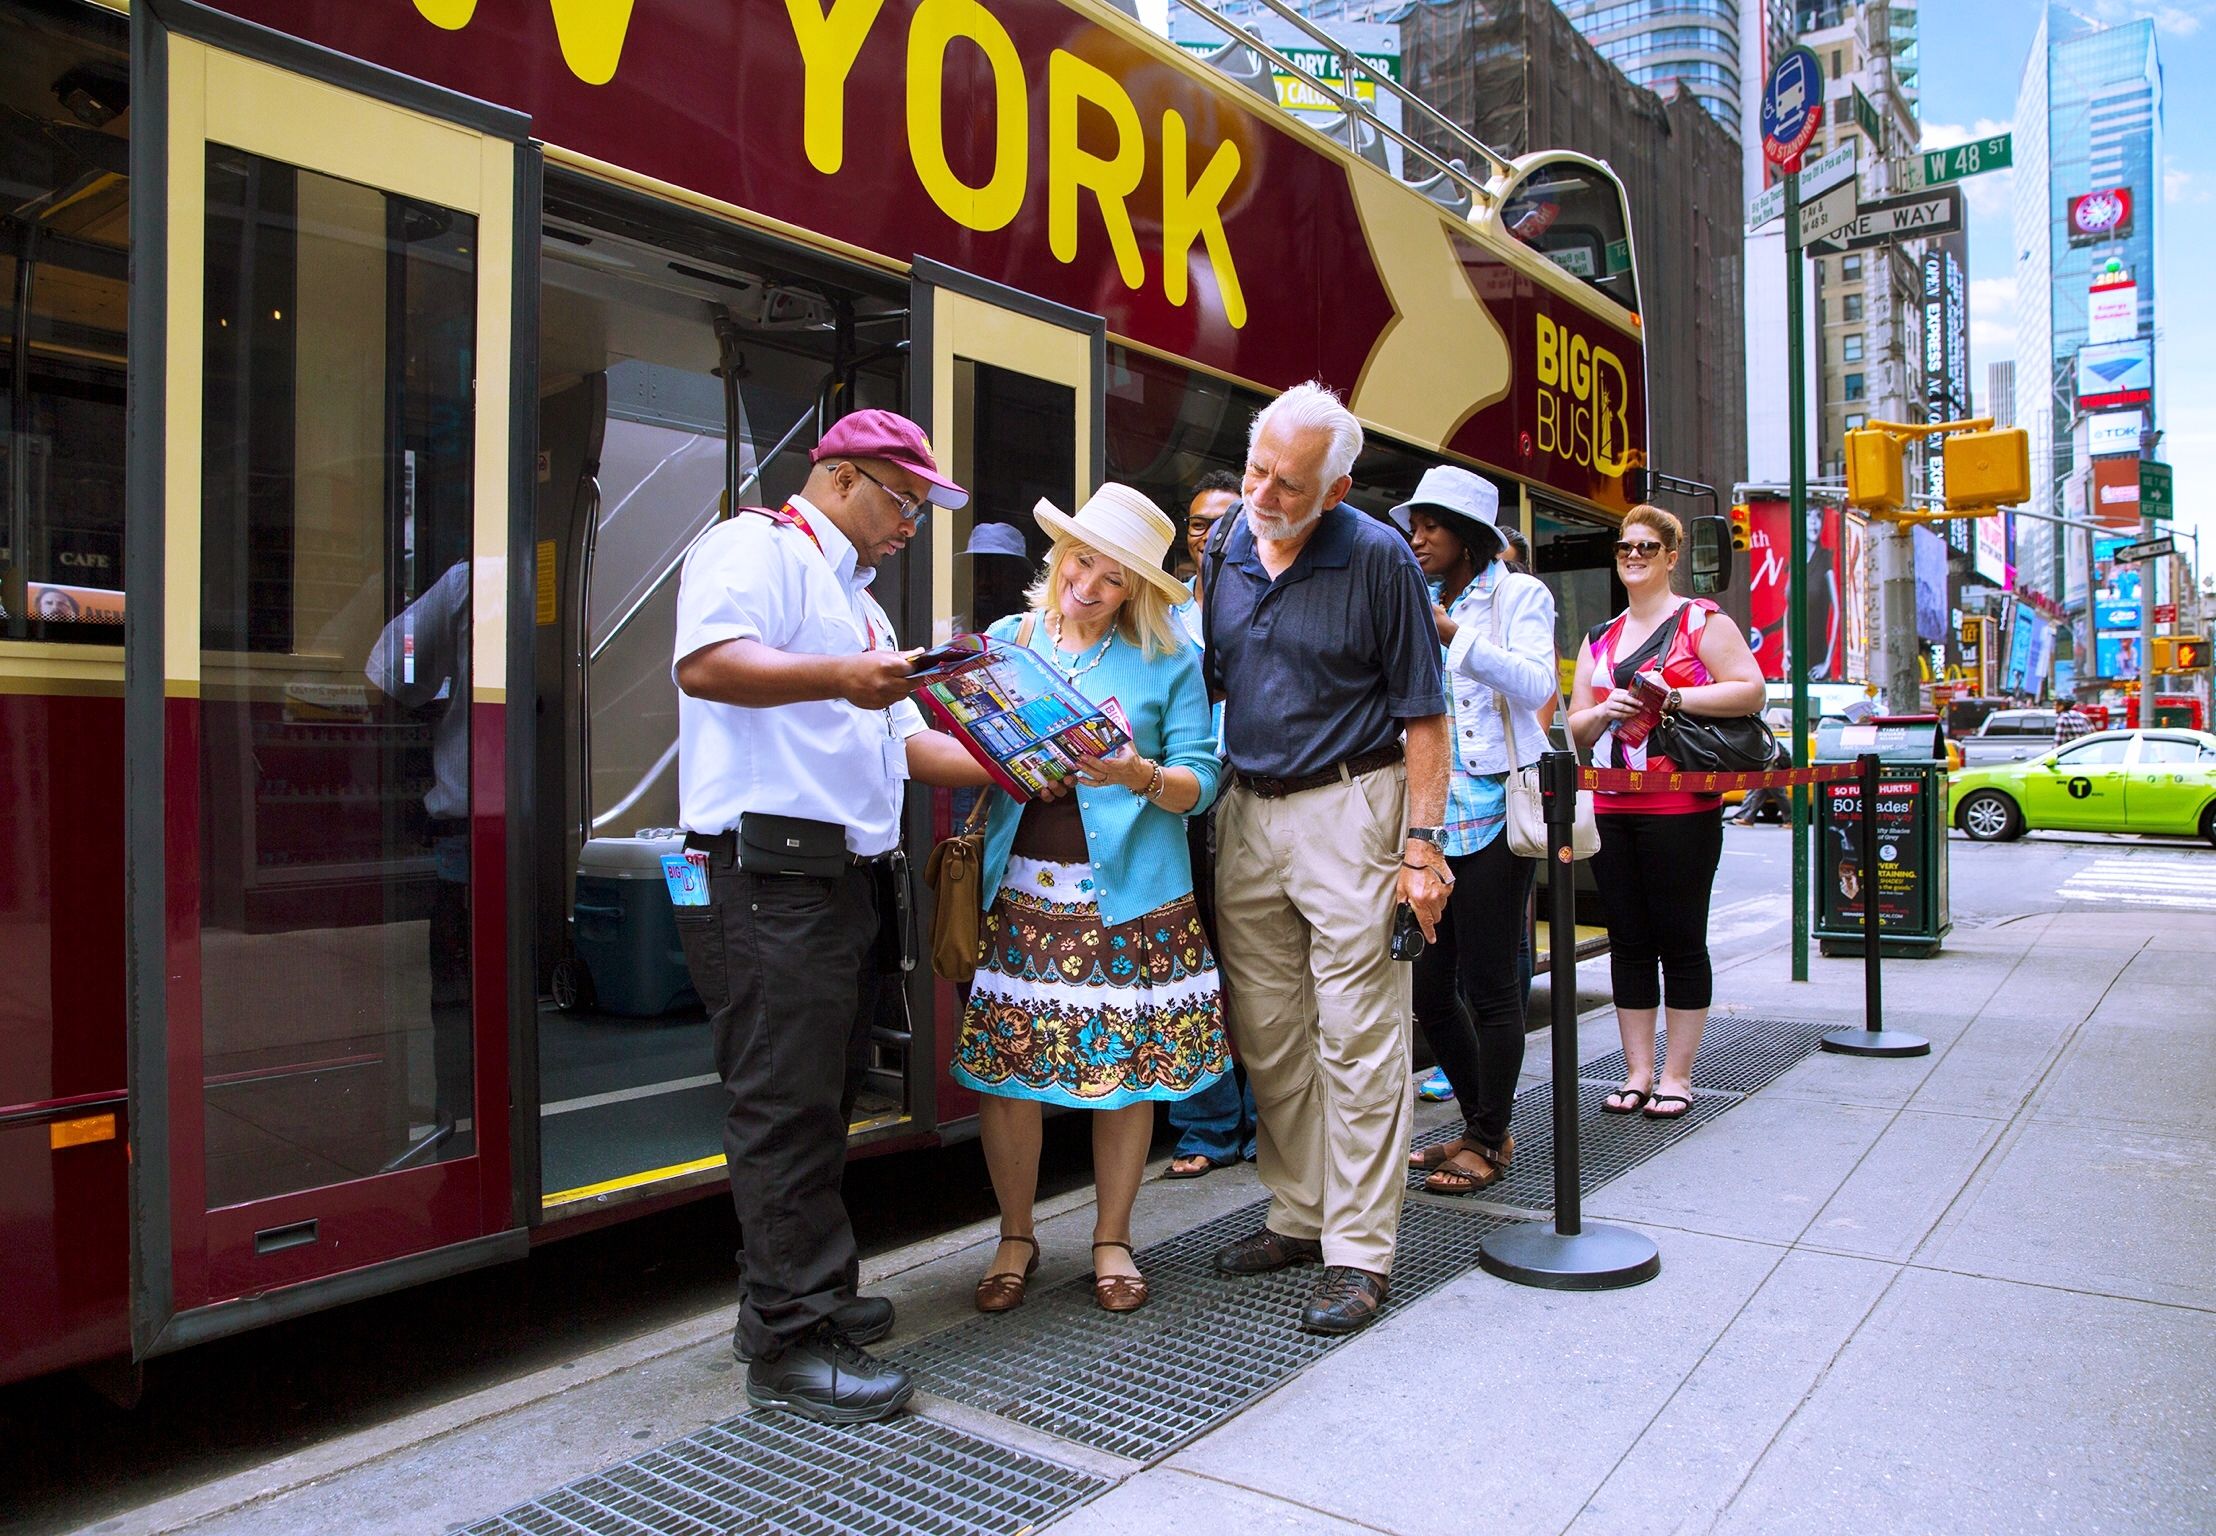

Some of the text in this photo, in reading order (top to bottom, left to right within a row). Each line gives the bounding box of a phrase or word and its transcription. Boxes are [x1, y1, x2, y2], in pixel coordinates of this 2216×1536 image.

[1293, 53, 1327, 77] DRY
[1766, 138, 1777, 157] NO
[1777, 113, 1817, 160] STANDING
[787, 0, 1246, 329] YORK
[1930, 152, 1946, 181] W
[1955, 144, 1980, 174] 48
[1988, 138, 2005, 156] ST
[1802, 170, 1812, 186] Drop
[1825, 157, 1836, 172] Pick
[1752, 200, 1760, 214] Big
[1760, 193, 1769, 208] Bus
[1802, 201, 1824, 220] 7 Av &
[1752, 207, 1774, 226] New York
[1802, 213, 1829, 234] W 48 St
[1829, 203, 1940, 239] ONE WAY
[1926, 259, 1941, 297] OPEN
[1926, 302, 1942, 373] EXPRESS
[1536, 312, 1591, 402] BIG
[1537, 388, 1592, 467] BUS
[2105, 426, 2138, 438] TDK
[2149, 542, 2167, 553] WAY
[60, 552, 111, 568] CAFE
[1105, 704, 1121, 724] BIG
[1020, 768, 1043, 791] Free!
[1834, 786, 1847, 795] SO
[1879, 784, 1912, 794] HURTS!
[1833, 798, 1854, 813] 50
[668, 866, 681, 879] BIG
